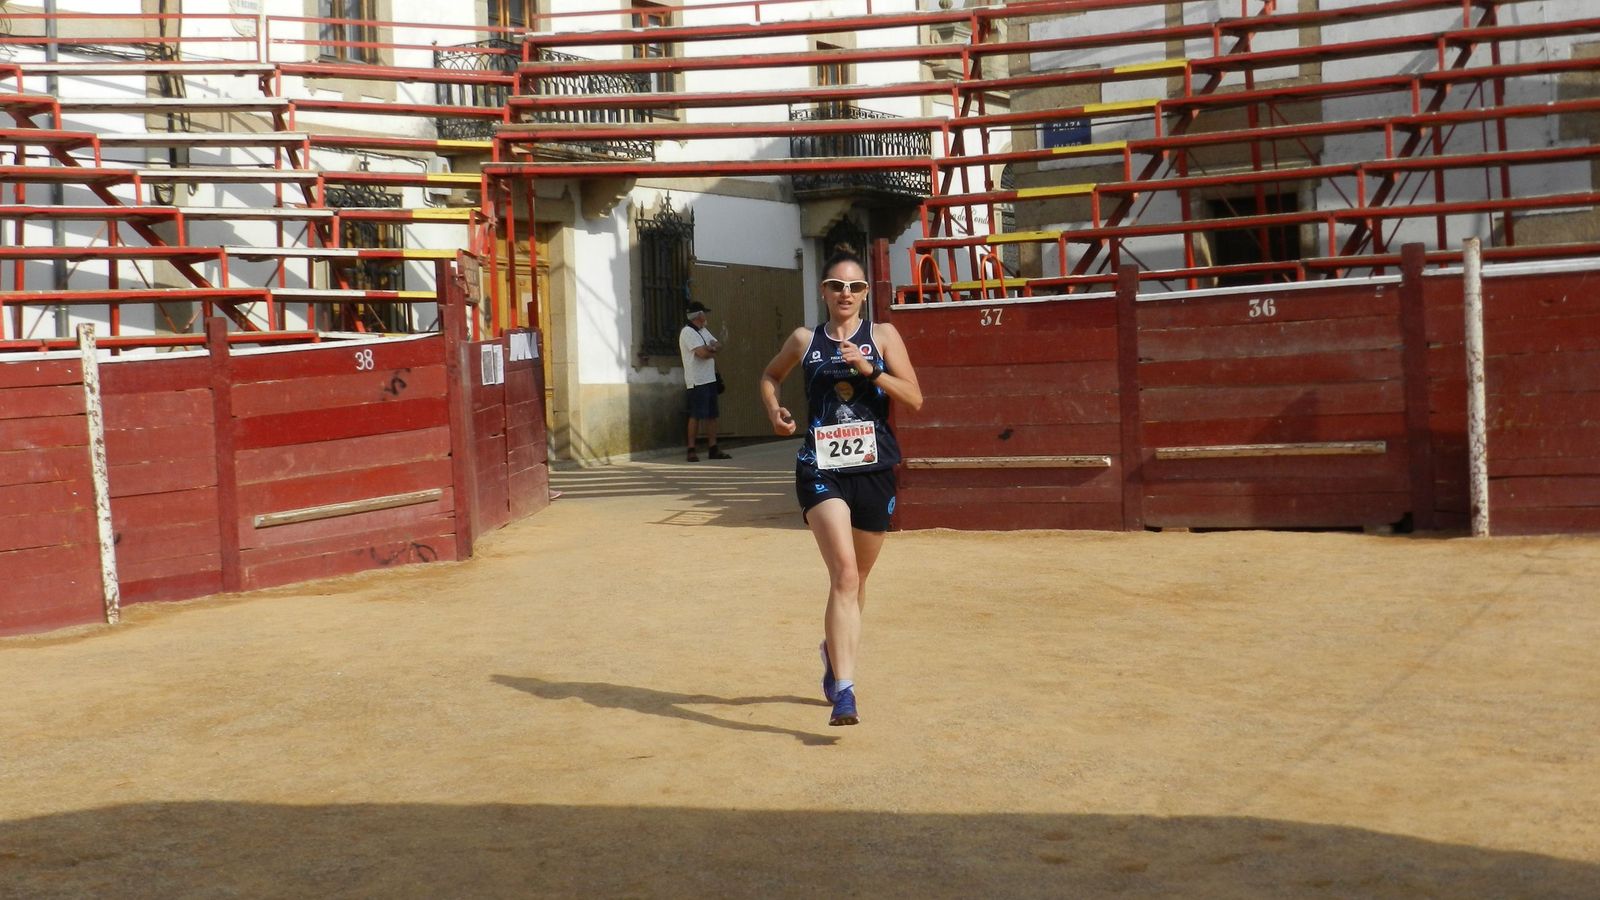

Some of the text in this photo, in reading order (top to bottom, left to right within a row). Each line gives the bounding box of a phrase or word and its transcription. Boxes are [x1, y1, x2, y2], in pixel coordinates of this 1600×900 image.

[981, 308, 1003, 326] 37
[1249, 298, 1276, 318] 36
[355, 349, 374, 371] 38
[829, 438, 865, 458] 262
